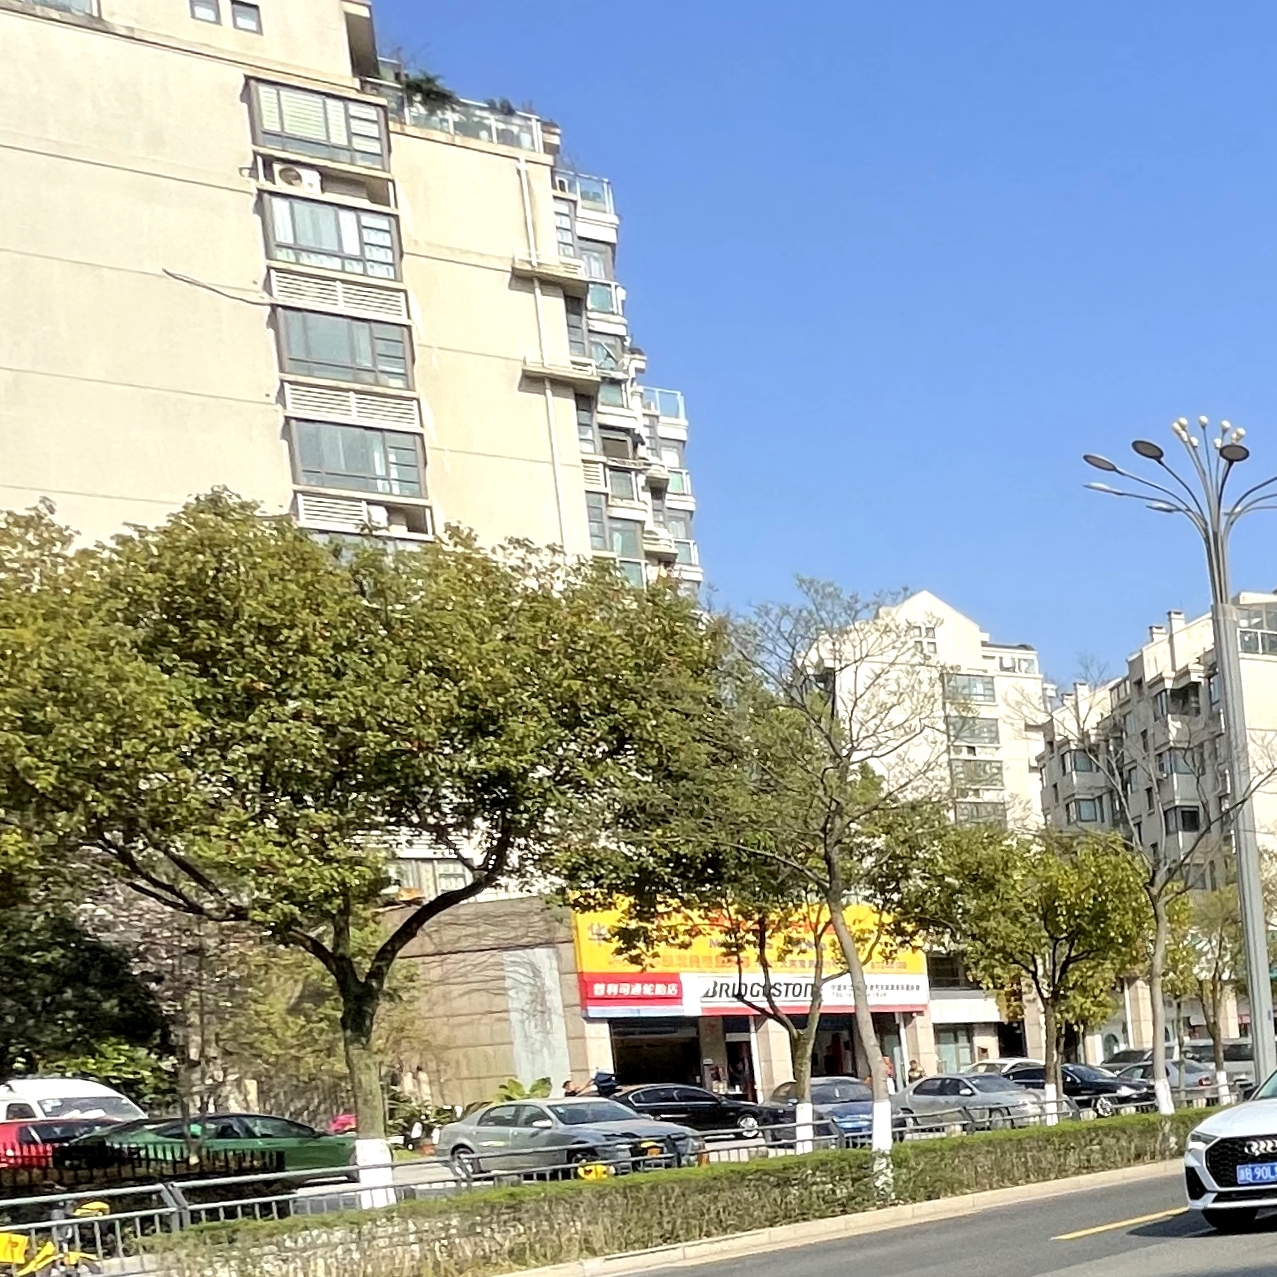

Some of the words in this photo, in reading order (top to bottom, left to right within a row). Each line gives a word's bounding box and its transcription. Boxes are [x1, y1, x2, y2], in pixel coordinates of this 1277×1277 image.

[593, 983, 678, 996] 普利司通轮胎店
